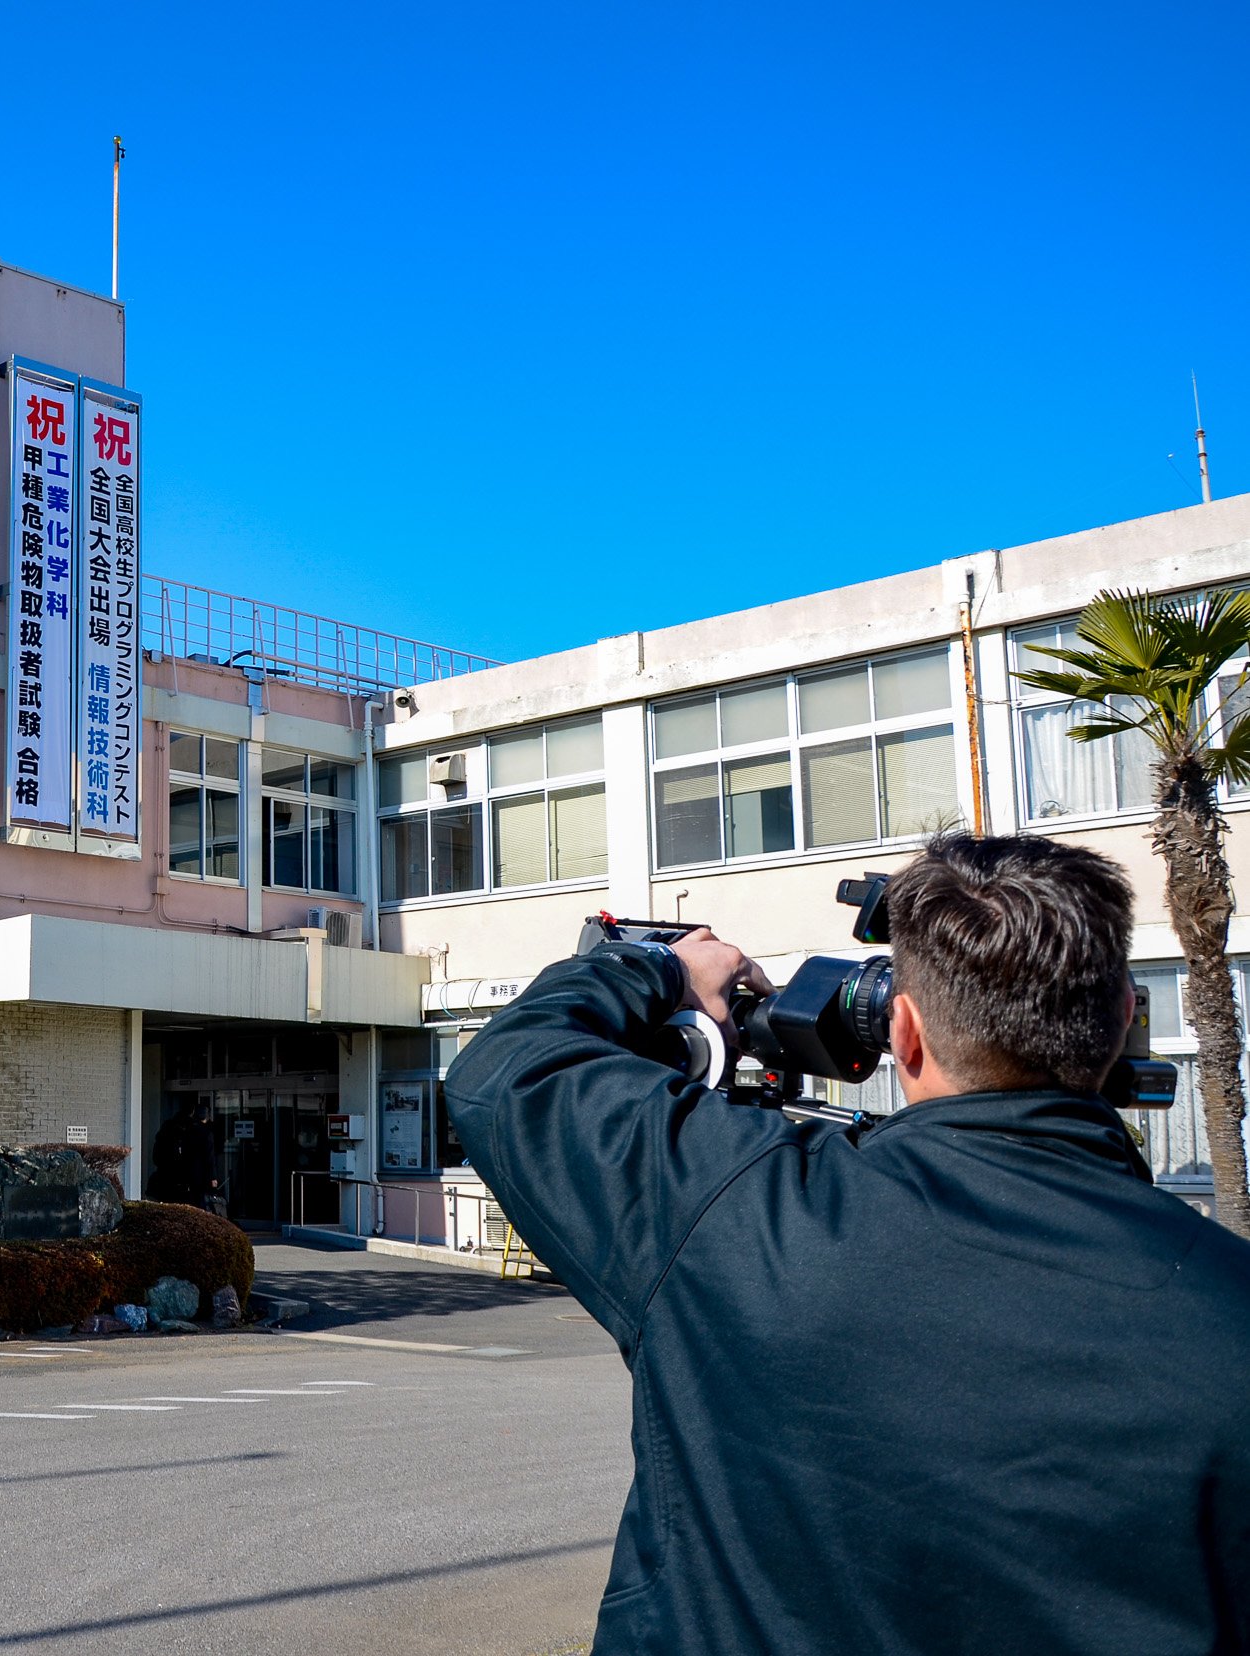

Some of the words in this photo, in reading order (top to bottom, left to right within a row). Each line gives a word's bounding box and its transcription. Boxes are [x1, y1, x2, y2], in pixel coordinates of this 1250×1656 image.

[26, 395, 65, 445] 祝
[93, 413, 131, 466] 祝
[46, 451, 69, 620] 工業化学科
[89, 466, 111, 647] 全国大会出場
[113, 474, 134, 824] 全国高校生プログラミングコンテスト
[86, 662, 111, 824] 情報技術科
